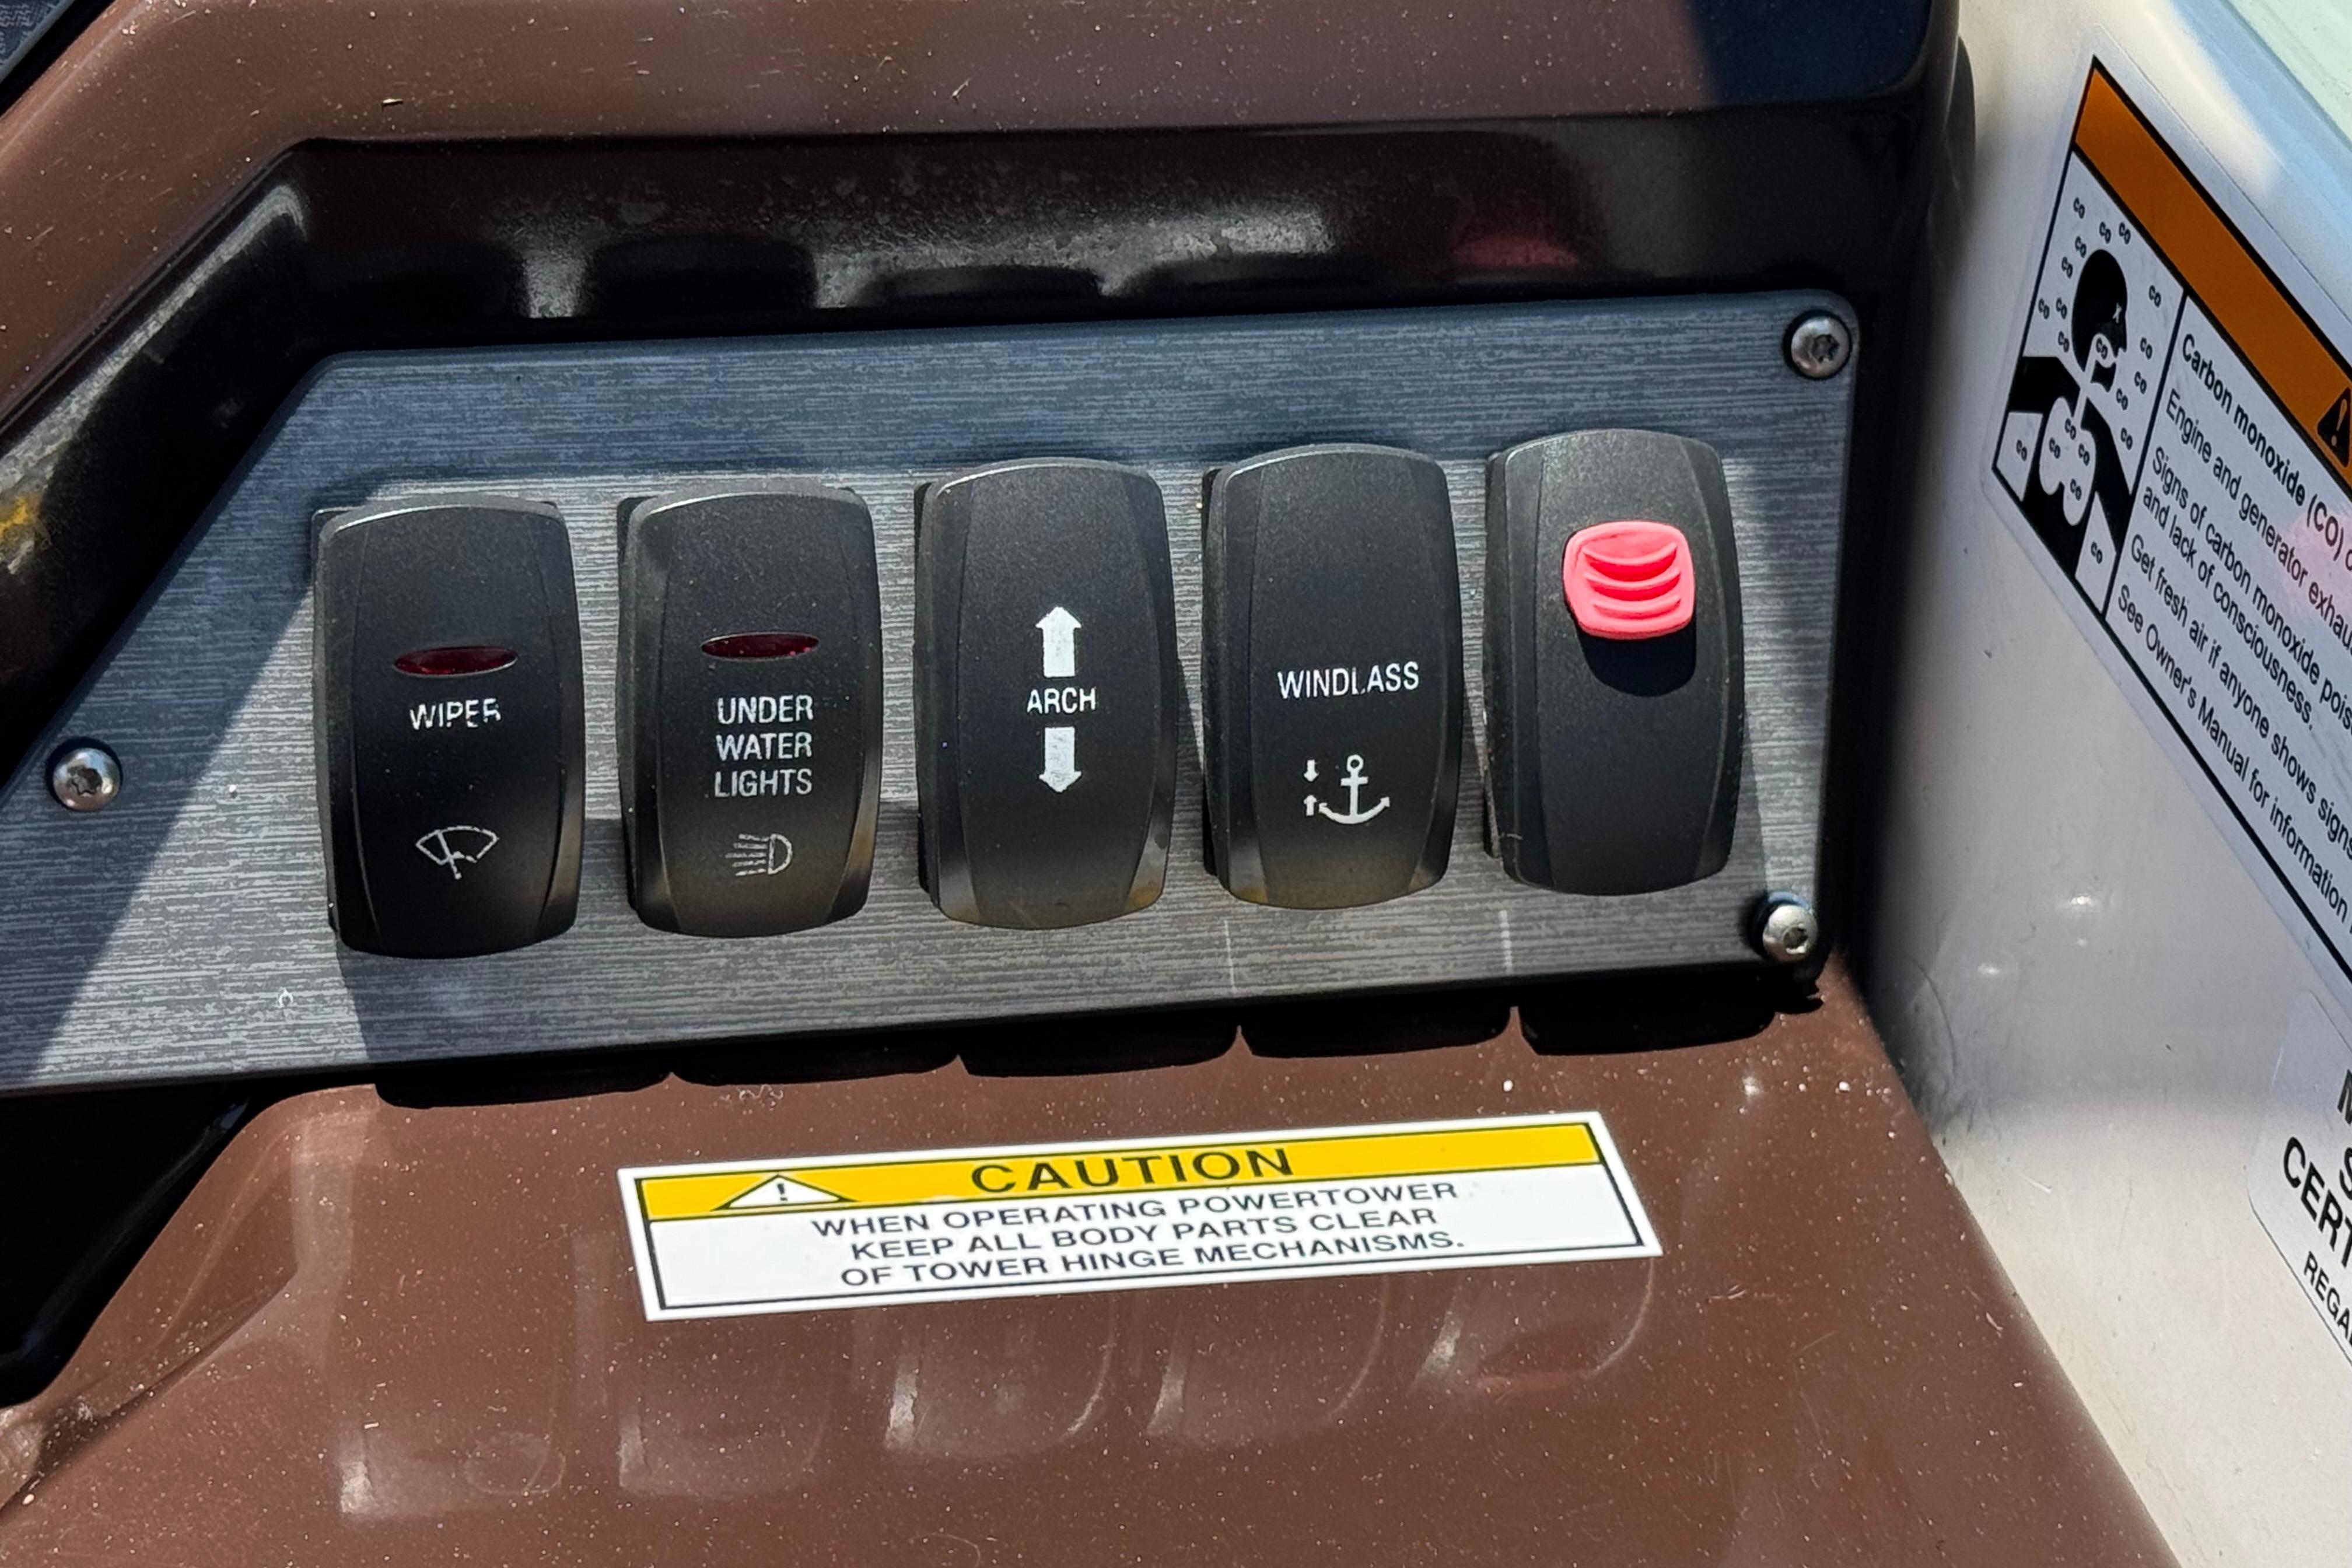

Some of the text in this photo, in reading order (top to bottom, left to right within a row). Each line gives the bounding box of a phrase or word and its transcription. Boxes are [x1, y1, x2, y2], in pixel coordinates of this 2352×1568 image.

[2183, 334, 2343, 561] Carbon monoxide (CO)
[2166, 388, 2352, 657] Engine and generator exhau
[2143, 487, 2312, 730] and lack of consciousness.
[2152, 447, 2352, 736] Signs of carbon monoxide pois
[1277, 662, 1420, 699] WINDLASS
[2132, 534, 2155, 582] Get
[2155, 566, 2188, 627] fresh
[2190, 620, 2208, 652] air
[2208, 639, 2222, 668] if
[2220, 662, 2269, 738] anyone
[2272, 733, 2316, 804] shows
[410, 698, 501, 731] WIPER
[717, 695, 814, 725] UNDER
[1027, 687, 1097, 715] ARCH
[715, 732, 813, 762] WATER
[2119, 584, 2347, 923] See Owner's Manual for information
[714, 768, 813, 799] LIGHTS
[972, 1147, 1293, 1194] CAUTION
[811, 1182, 1457, 1238] WHEN OPERATING POWERTOWER
[852, 1207, 1437, 1261] KEEP ALL BODY PARTS CLEAR
[841, 1231, 1464, 1287] OF TOWER HINGE MECHANISMS.
[2304, 1250, 2352, 1348] REGA
